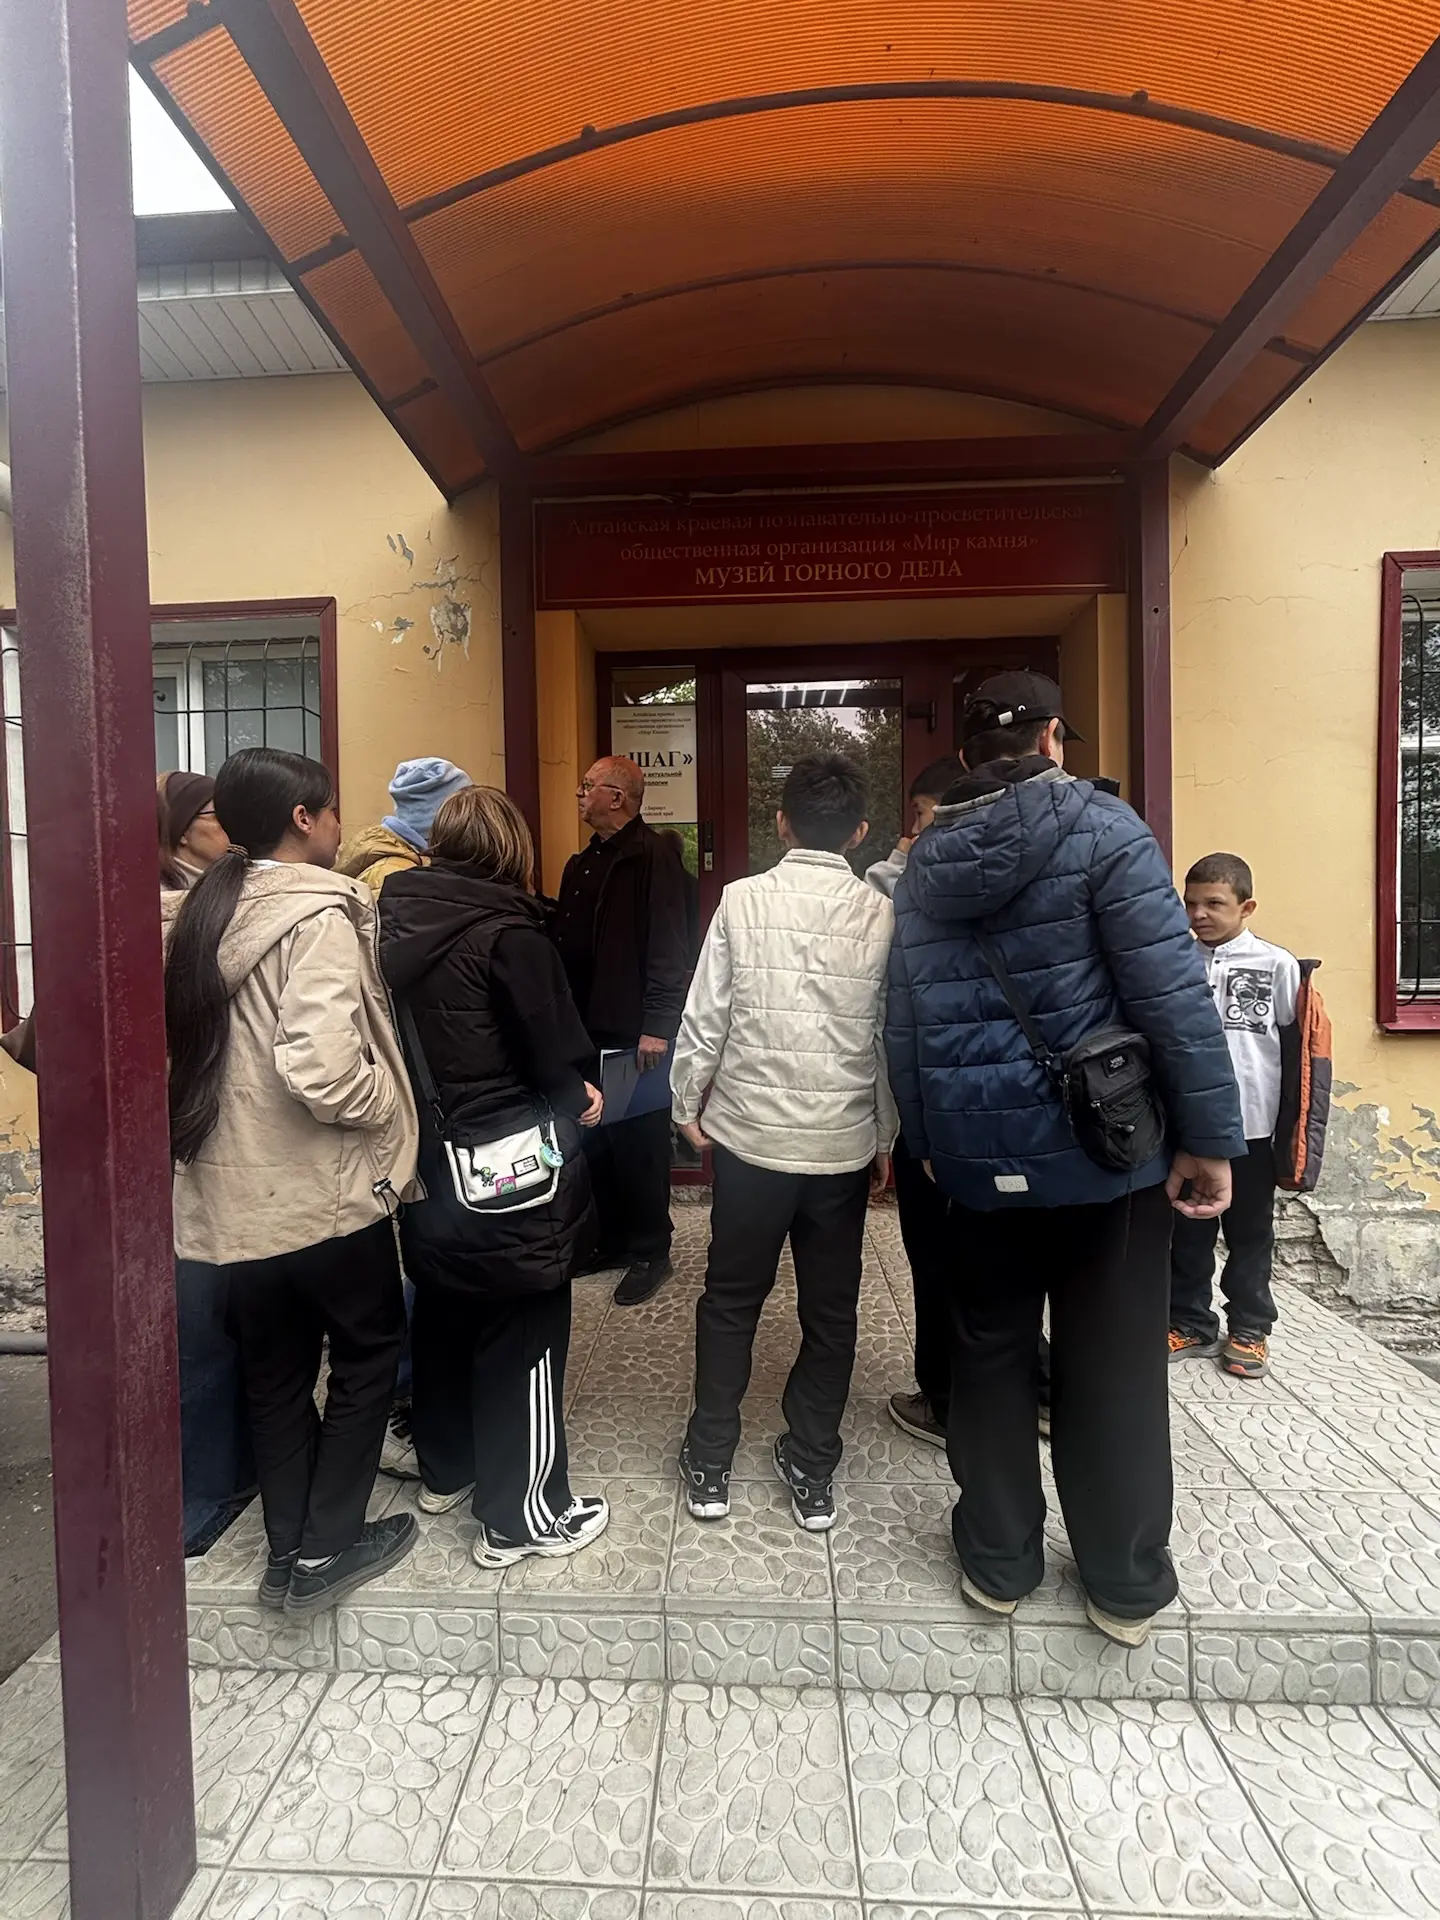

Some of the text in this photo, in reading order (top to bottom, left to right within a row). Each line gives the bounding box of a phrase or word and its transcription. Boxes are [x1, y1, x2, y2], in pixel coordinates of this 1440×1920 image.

[568, 505, 1089, 537] Алтайская краевая познавательно-просветительска
[620, 533, 1040, 562] общественная организация «Мир камня»
[695, 560, 964, 588] МУЗЕЙ ГОРНОГО ДЕЛА
[617, 751, 693, 768] ШАГ»
